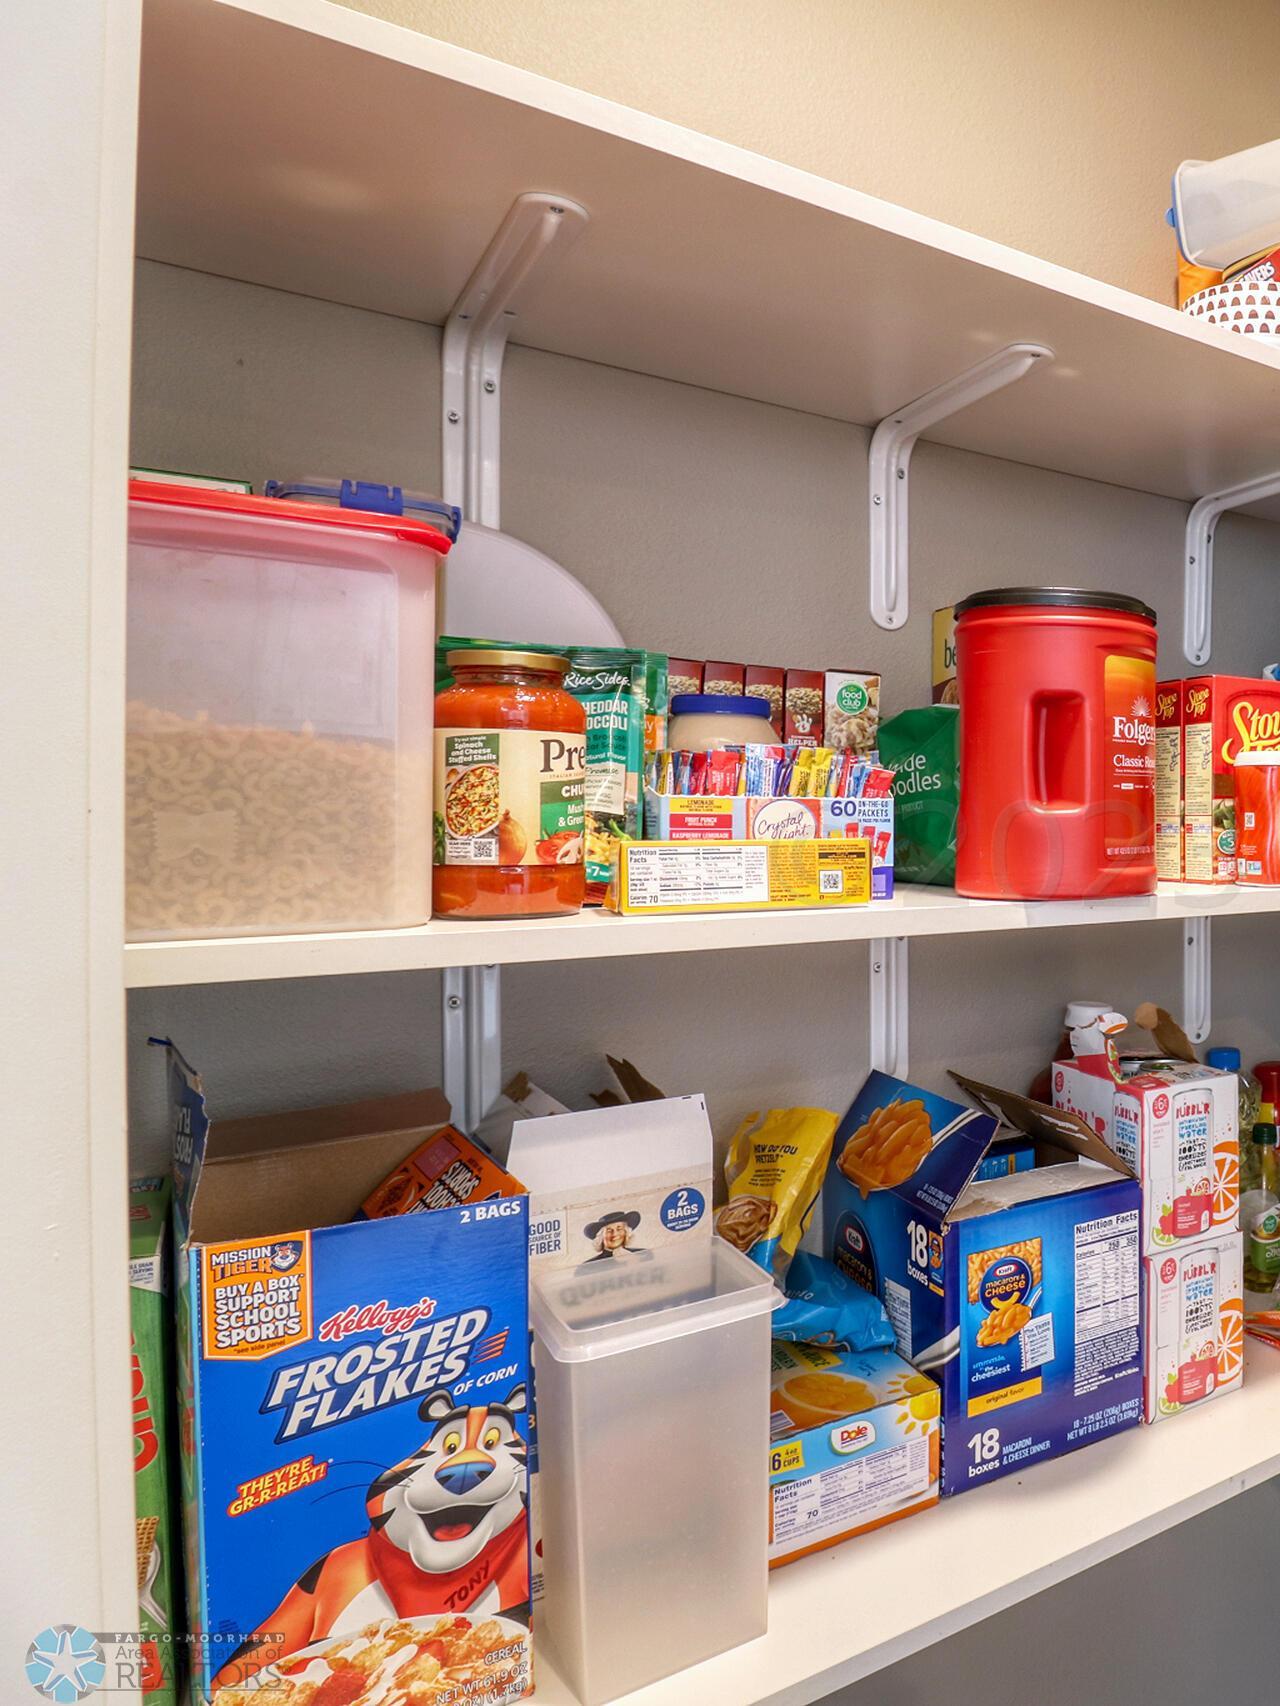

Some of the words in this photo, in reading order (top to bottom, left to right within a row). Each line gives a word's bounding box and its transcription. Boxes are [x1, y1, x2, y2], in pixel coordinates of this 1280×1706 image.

[565, 672, 592, 688] Rice
[594, 671, 629, 690] Sides
[842, 689, 863, 699] food
[842, 697, 861, 707] club
[1186, 688, 1210, 713] Stove
[1155, 693, 1177, 716] Stove
[1194, 704, 1206, 718] Top
[454, 741, 484, 750] Spinach
[788, 738, 818, 747] HELPER
[448, 756, 472, 764] Stuffed
[473, 754, 496, 762] Shells
[464, 748, 491, 756] Cheese
[1113, 754, 1144, 767] Classic
[830, 800, 856, 816] 60
[858, 809, 889, 817] PACKETS
[758, 811, 804, 839] Crystal
[629, 849, 657, 857] Nutrition
[649, 895, 659, 904] 70
[676, 1190, 689, 1206] 2
[460, 1210, 471, 1224] 2
[475, 1201, 521, 1221] BAGS
[667, 1203, 699, 1220] BAGS
[529, 1219, 561, 1236] GOOD
[1076, 1219, 1114, 1234] Nutrition
[1116, 1213, 1138, 1225] Facts
[529, 1239, 562, 1257] FIBER
[907, 1219, 928, 1268] 18
[211, 1244, 272, 1269] MISSION
[1076, 1249, 1095, 1258] Calories
[907, 1259, 929, 1286] boxes
[998, 1265, 1014, 1275] Kraft
[985, 1275, 1020, 1290] macaroni
[215, 1288, 300, 1315] SUPPORT
[215, 1308, 300, 1333] SCHOOL
[216, 1321, 301, 1350] SPORTS
[268, 1308, 488, 1407] FROSTED
[453, 1380, 474, 1396] OF
[476, 1364, 518, 1389] CORN
[971, 1363, 1011, 1383] cheesiest
[281, 1345, 468, 1439] FLAKES
[986, 1391, 1009, 1404] original
[1010, 1387, 1025, 1397] flavor
[1121, 1399, 1139, 1413] BOXES
[841, 1425, 868, 1441] Dole
[1067, 1430, 1077, 1441] NET
[1078, 1426, 1087, 1437] WT
[1109, 1416, 1116, 1427] OZ
[968, 1428, 1000, 1465] 18
[1002, 1437, 1032, 1456] MACARONI
[1009, 1448, 1030, 1464] CHEESE
[1030, 1440, 1051, 1457] DINNER
[783, 1456, 800, 1467] CUPS
[968, 1458, 1000, 1478] boxes
[240, 1456, 313, 1497] THEY'RE
[230, 1465, 327, 1514] GR-R-REAT!
[774, 1478, 813, 1496] Nutrition
[774, 1491, 798, 1503] Facts
[807, 1509, 819, 1519] 70
[443, 1560, 490, 1609] TONY
[484, 1642, 528, 1666] CEREAL
[436, 1686, 460, 1705] NET
[462, 1679, 481, 1695] WT
[483, 1668, 508, 1688] 61.9
[511, 1661, 528, 1677] OZ
